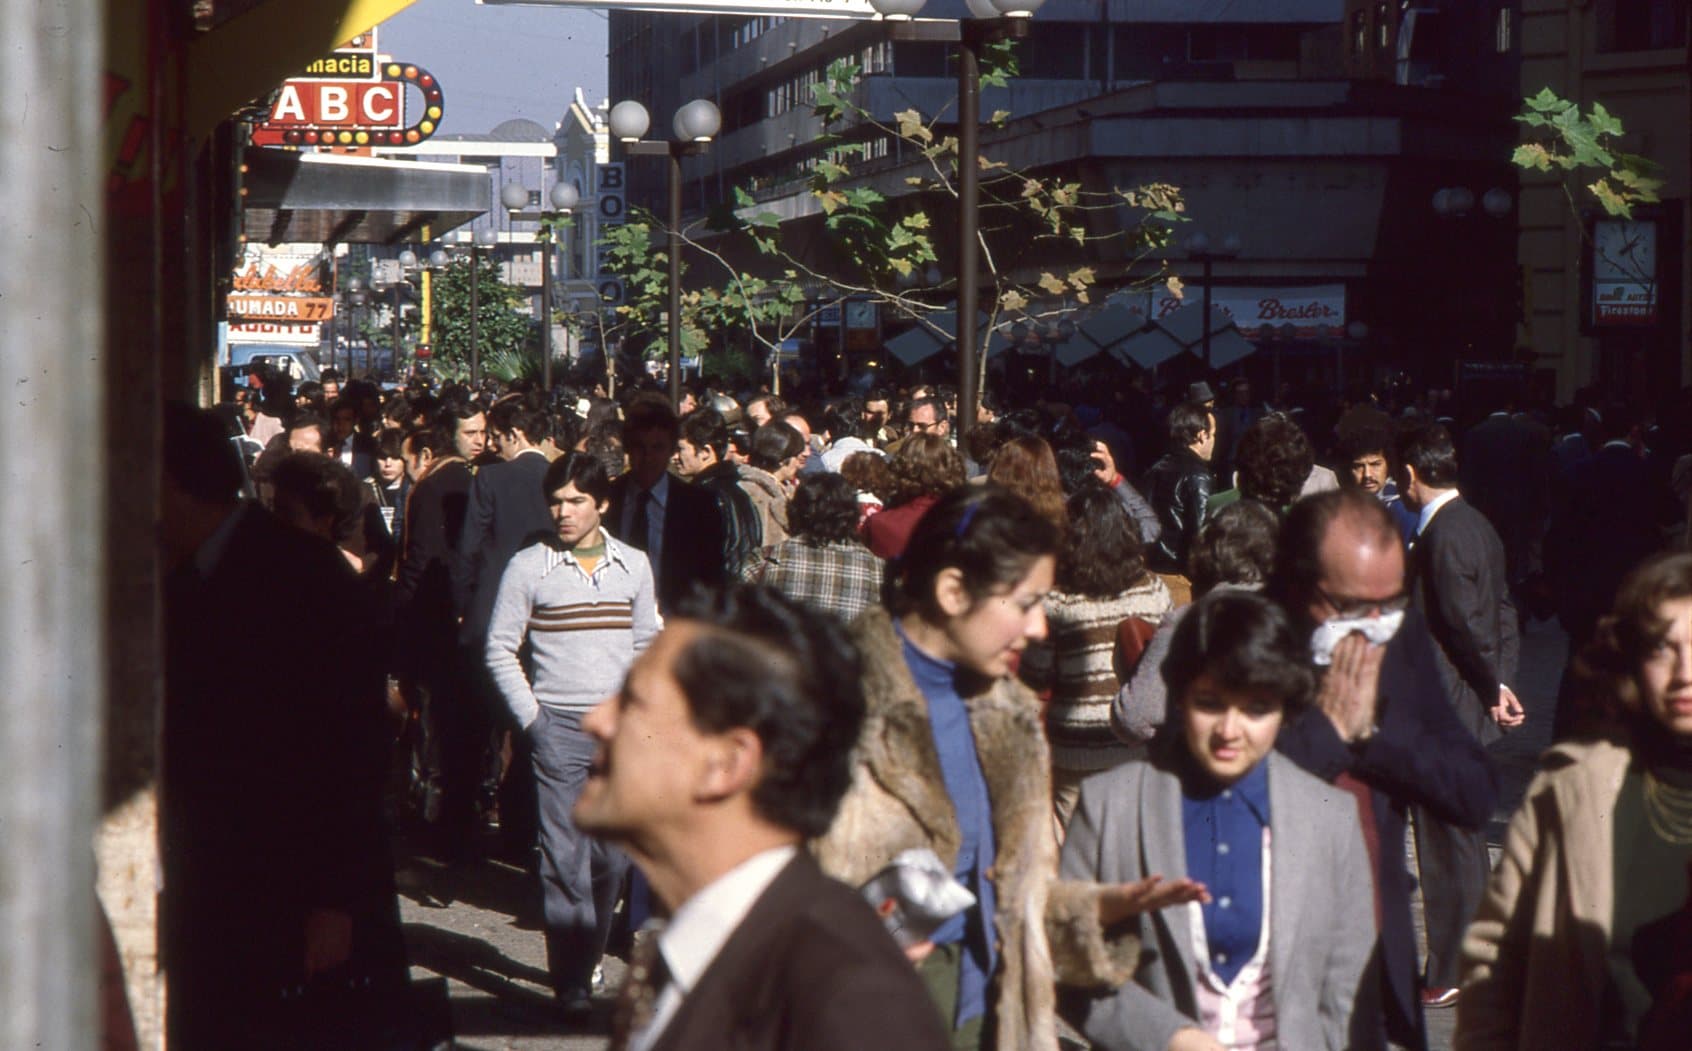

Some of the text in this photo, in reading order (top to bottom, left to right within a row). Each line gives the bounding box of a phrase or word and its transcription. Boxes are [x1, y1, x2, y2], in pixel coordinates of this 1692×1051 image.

[274, 85, 393, 121] ABC
[600, 166, 622, 305] BOO
[306, 302, 328, 318] 77
